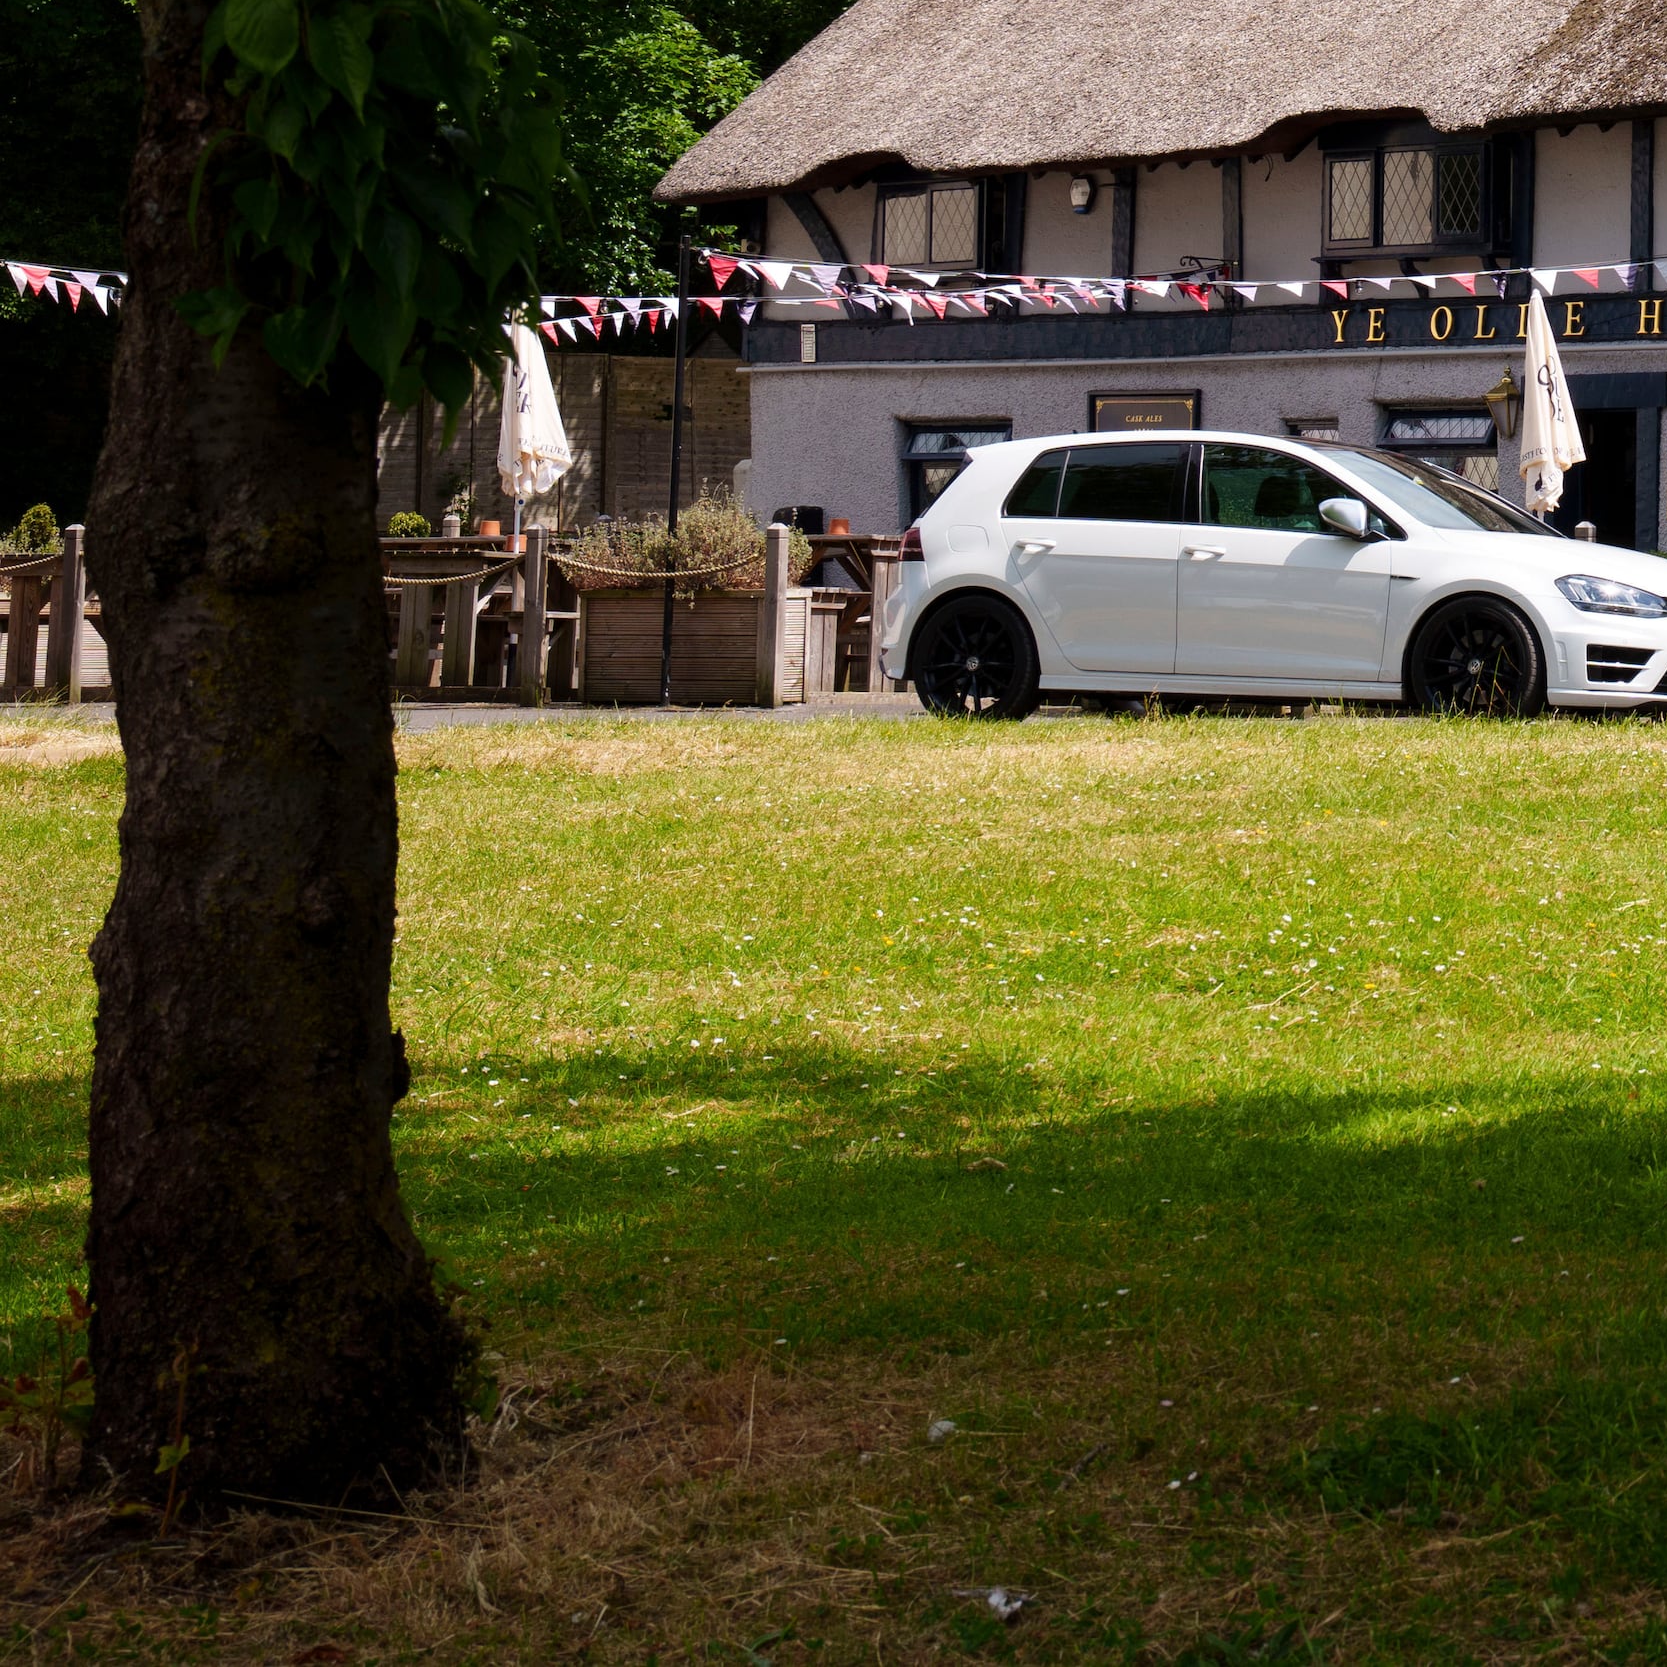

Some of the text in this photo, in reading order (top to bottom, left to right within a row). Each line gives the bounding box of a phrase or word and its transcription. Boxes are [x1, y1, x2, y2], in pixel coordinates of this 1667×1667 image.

[1333, 309, 1384, 342] YE
[1125, 415, 1163, 423] CASK ALES
